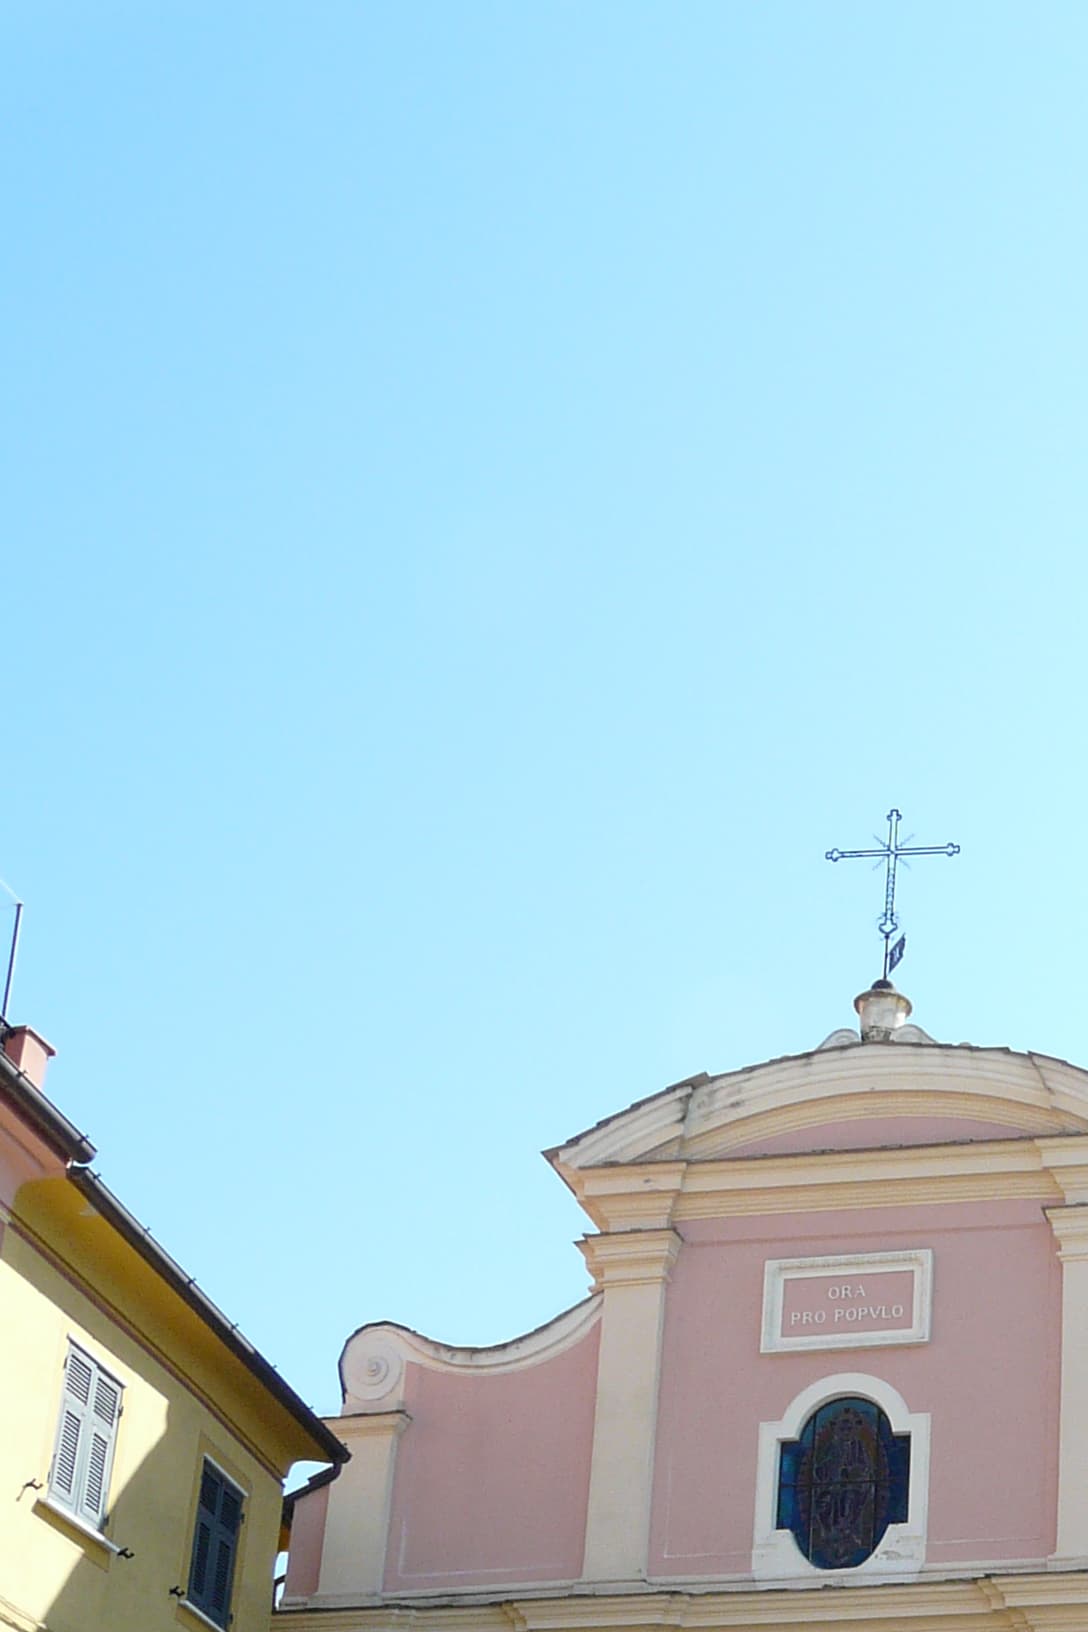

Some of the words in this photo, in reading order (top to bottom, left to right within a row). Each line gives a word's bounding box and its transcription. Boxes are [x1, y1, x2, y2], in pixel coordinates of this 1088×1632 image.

[828, 1285, 866, 1300] ORA
[791, 1310, 826, 1325] PRO
[834, 1304, 904, 1322] POPVLO
